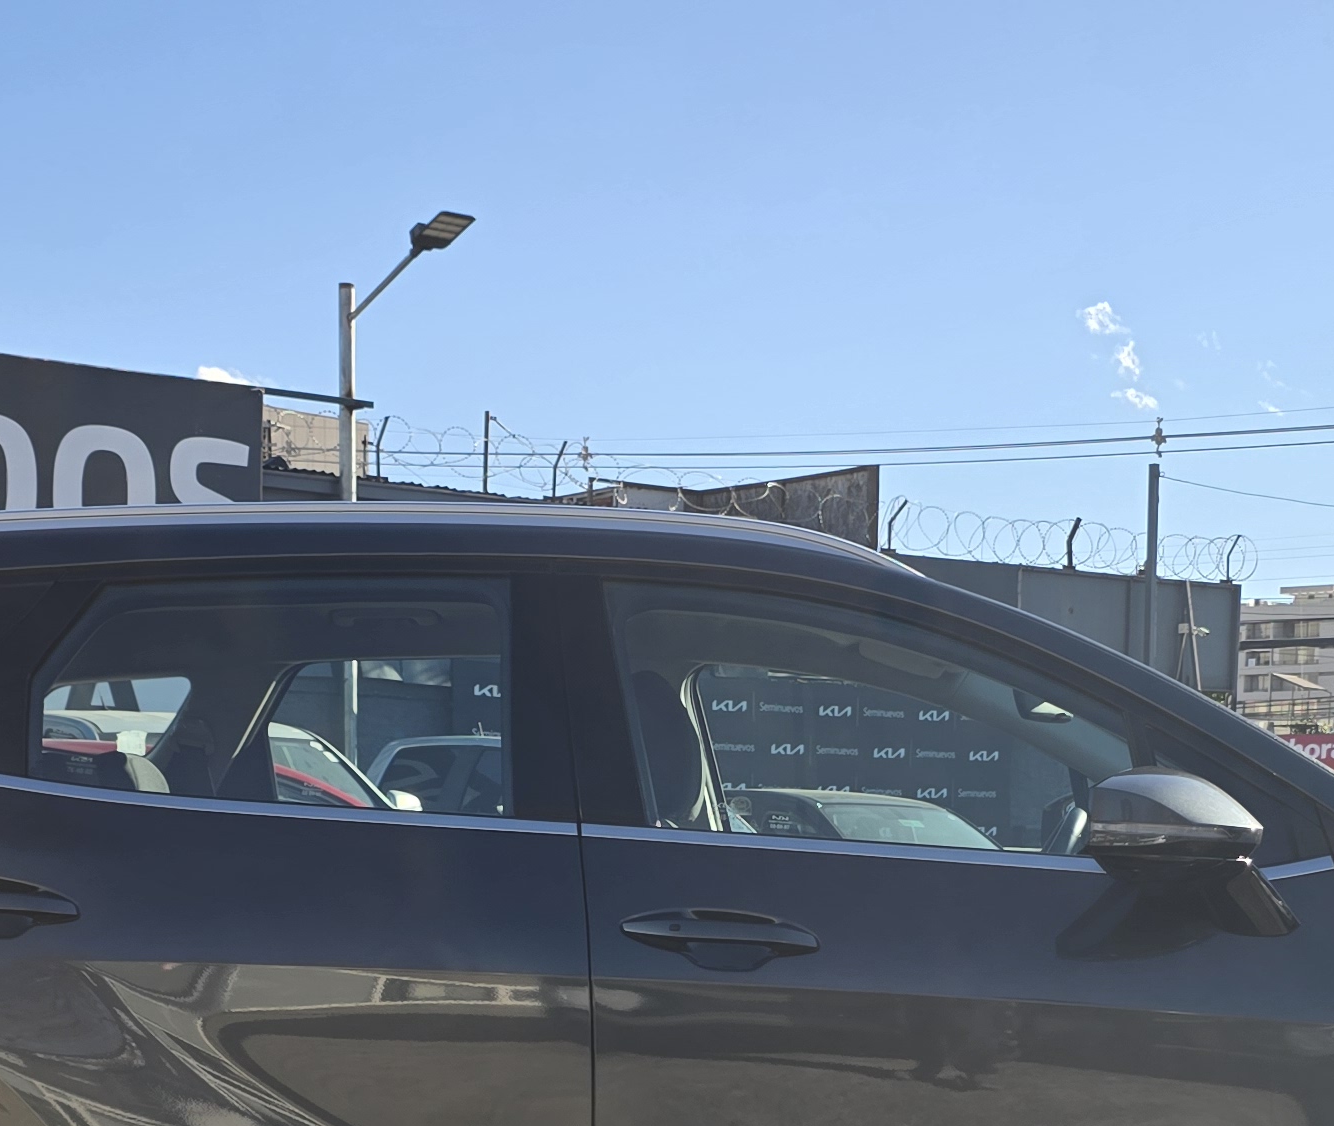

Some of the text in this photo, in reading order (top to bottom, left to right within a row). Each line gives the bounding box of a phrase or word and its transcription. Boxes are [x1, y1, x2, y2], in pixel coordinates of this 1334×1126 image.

[474, 684, 501, 697] KI
[712, 700, 748, 712] KIA
[759, 702, 804, 714] Seminuevos
[819, 705, 852, 717] KIA
[863, 707, 905, 719] Seminuevos
[919, 710, 950, 721] KIA
[713, 741, 755, 752] eminuevos
[771, 743, 805, 755] KIA
[873, 747, 905, 759] KIA
[969, 750, 999, 761] KIA
